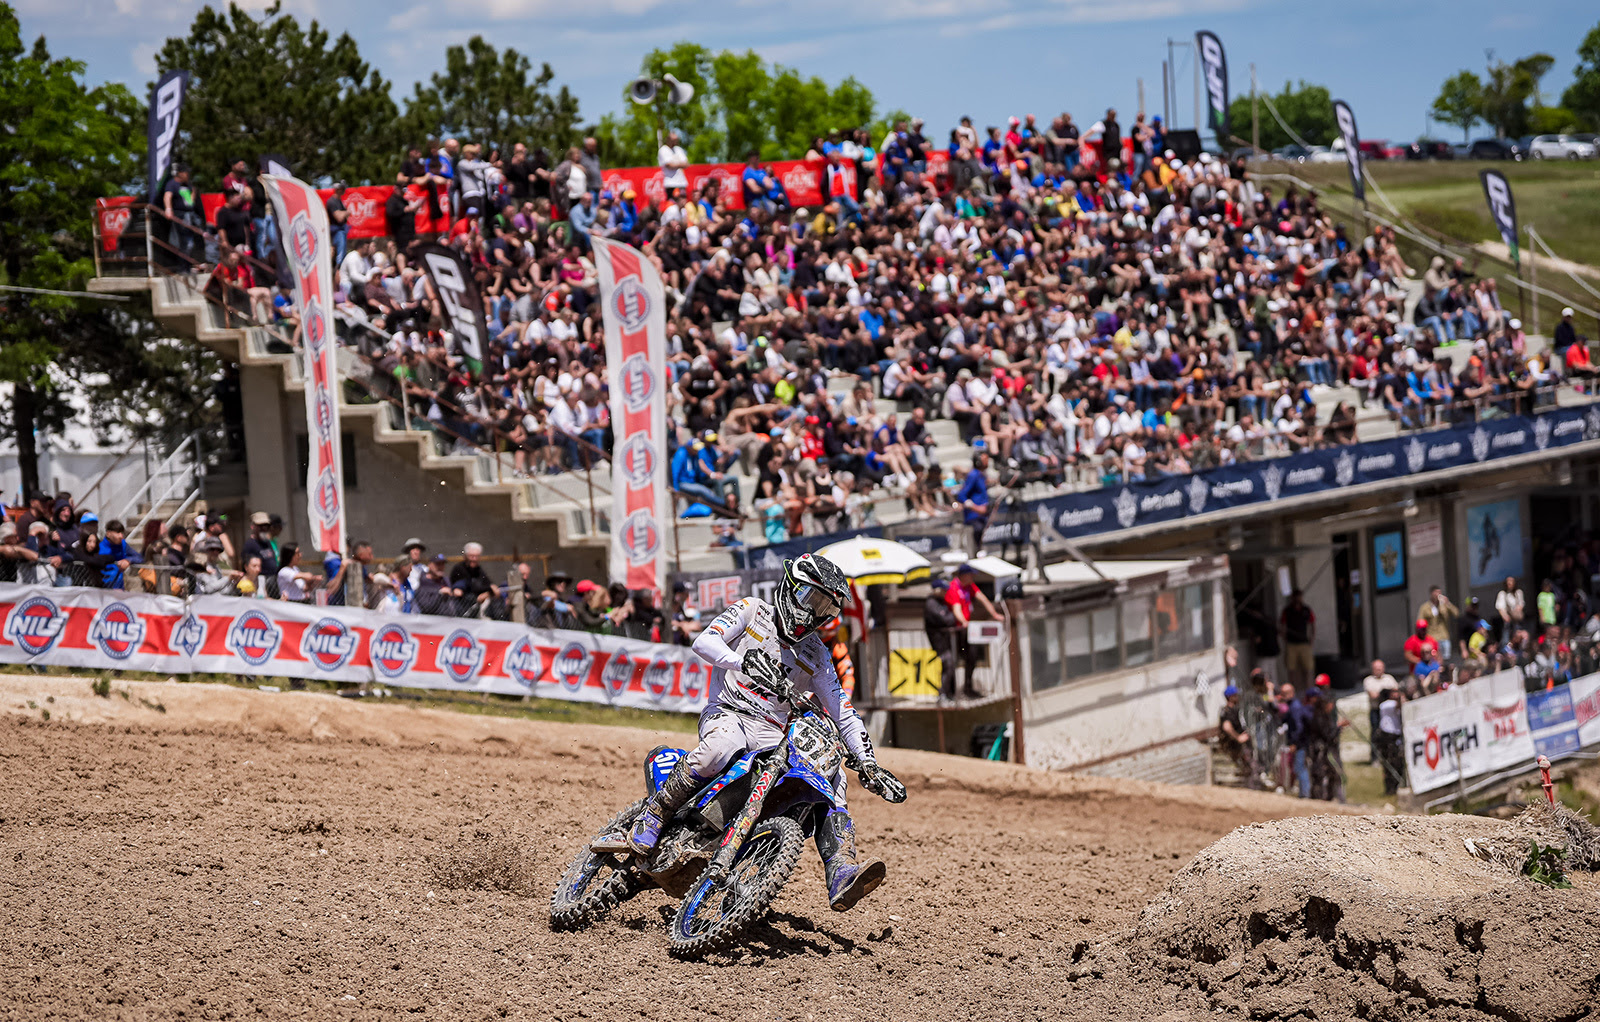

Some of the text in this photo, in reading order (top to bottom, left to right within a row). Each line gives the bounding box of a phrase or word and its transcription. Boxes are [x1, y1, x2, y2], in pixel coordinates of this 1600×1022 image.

[9, 615, 66, 637] NILS
[94, 619, 142, 643] NILS
[231, 626, 280, 650] NILS
[305, 634, 354, 655] NILS
[372, 638, 417, 661] NILS
[438, 644, 483, 667] NILS
[913, 660, 921, 684] 1
